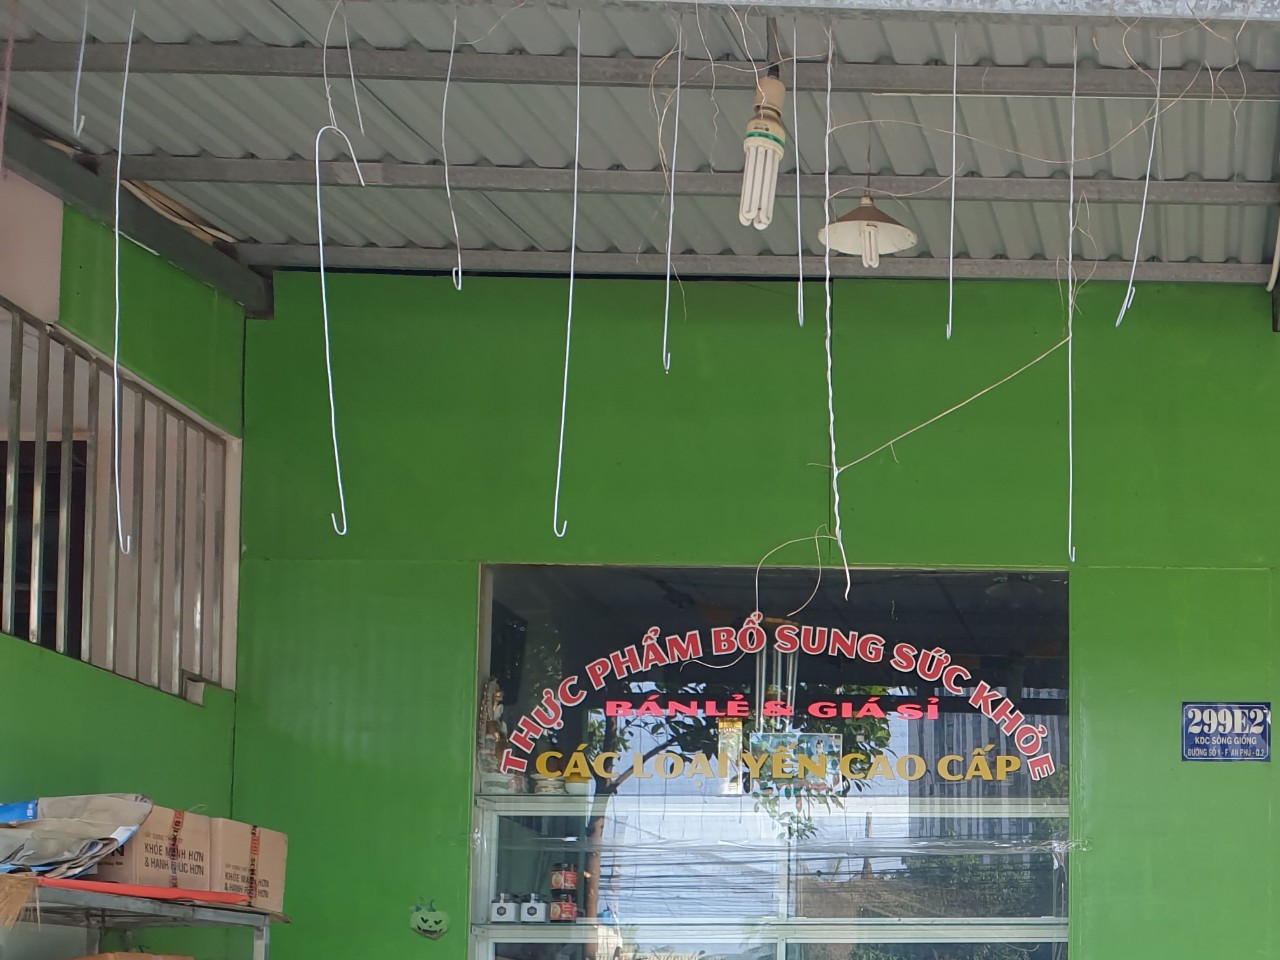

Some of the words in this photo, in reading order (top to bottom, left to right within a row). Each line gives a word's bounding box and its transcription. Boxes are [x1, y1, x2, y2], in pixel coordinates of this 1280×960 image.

[500, 674, 587, 775] THỰC
[586, 625, 703, 692] PHẨM
[711, 611, 767, 655] BỔ
[773, 624, 886, 663] SUNG
[889, 640, 972, 697] SỨC
[967, 680, 1057, 782] KHỎE
[762, 700, 794, 718] &
[807, 694, 886, 719] GIÁ
[889, 695, 940, 720] SỈ
[1187, 708, 1265, 734] 299E2
[1194, 737, 1210, 745] KDC
[535, 742, 621, 779] CÁC
[631, 751, 728, 788] LOẠI
[742, 735, 828, 781] YẾN
[840, 750, 927, 781] CAO
[937, 742, 1021, 781] CẤP
